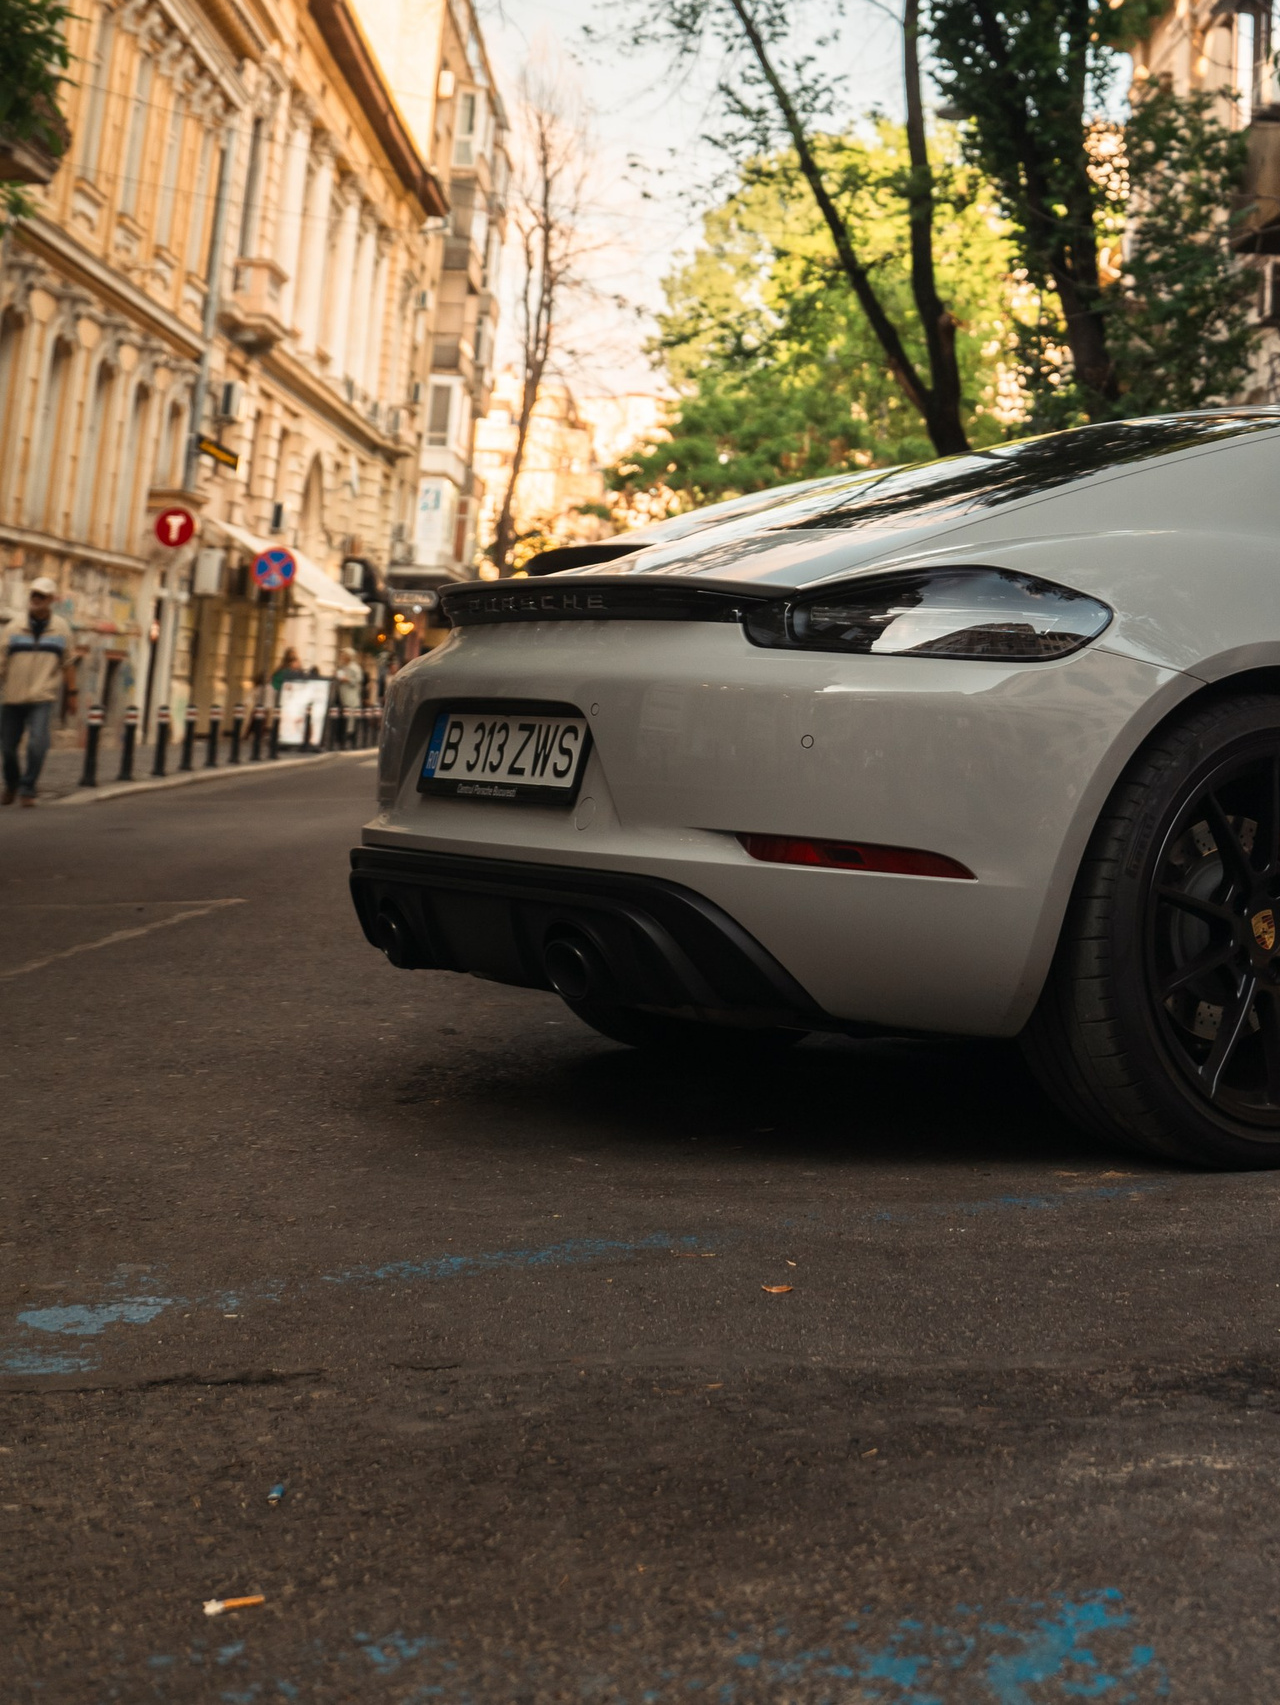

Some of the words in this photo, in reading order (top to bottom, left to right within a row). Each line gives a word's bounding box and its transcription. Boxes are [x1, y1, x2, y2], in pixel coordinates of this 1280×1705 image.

[426, 750, 439, 770] RO
[439, 721, 465, 771] B
[466, 722, 510, 773] 313
[507, 723, 579, 778] ZWS
